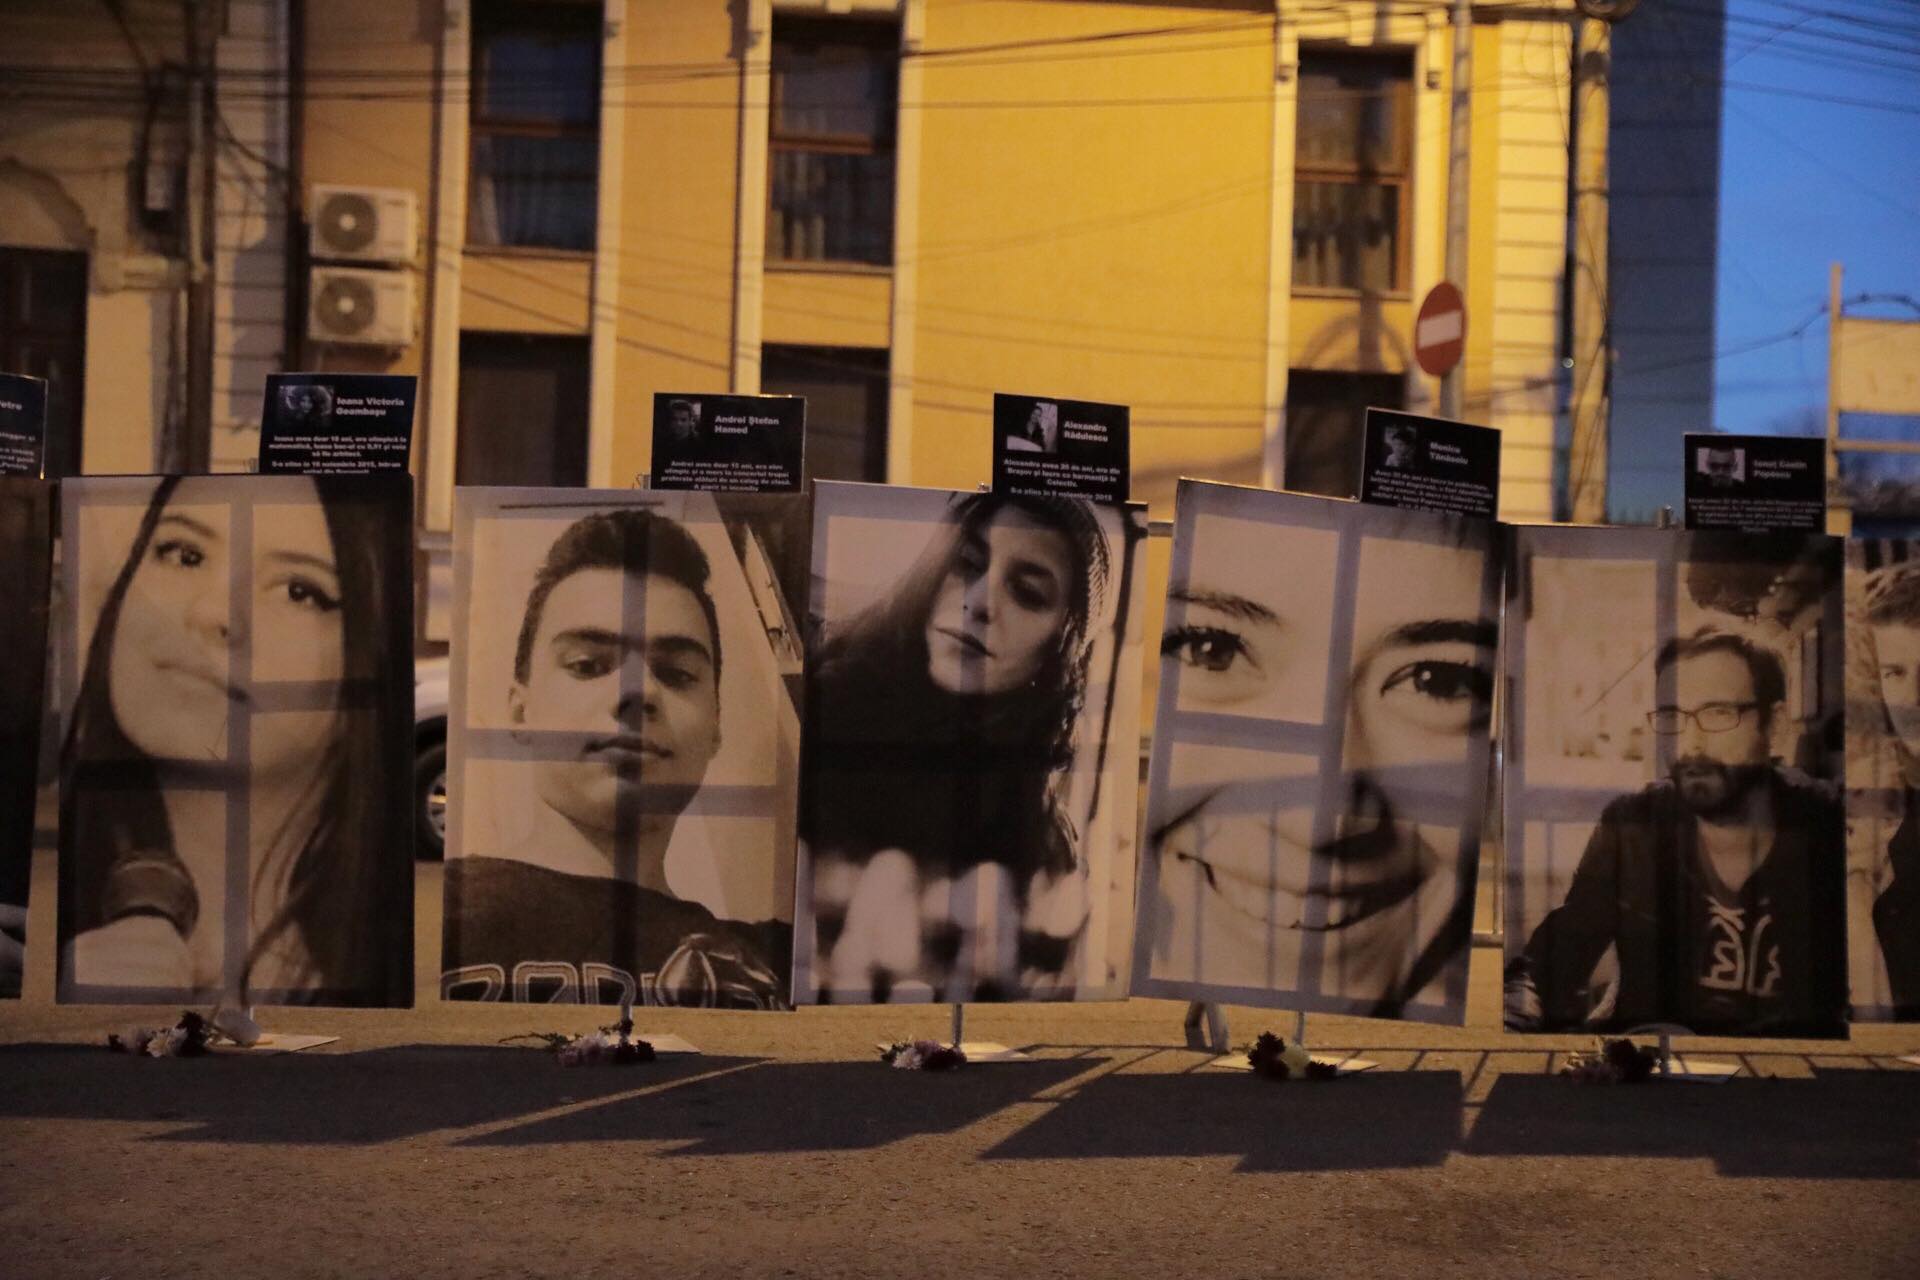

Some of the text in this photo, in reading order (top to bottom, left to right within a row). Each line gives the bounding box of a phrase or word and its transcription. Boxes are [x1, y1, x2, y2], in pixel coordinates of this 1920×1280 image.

[0, 401, 22, 411] etre
[336, 397, 404, 406] Ioana Victoria
[715, 415, 746, 424] Andrei
[714, 425, 748, 435] Hamed
[1064, 420, 1107, 432] Alexandra
